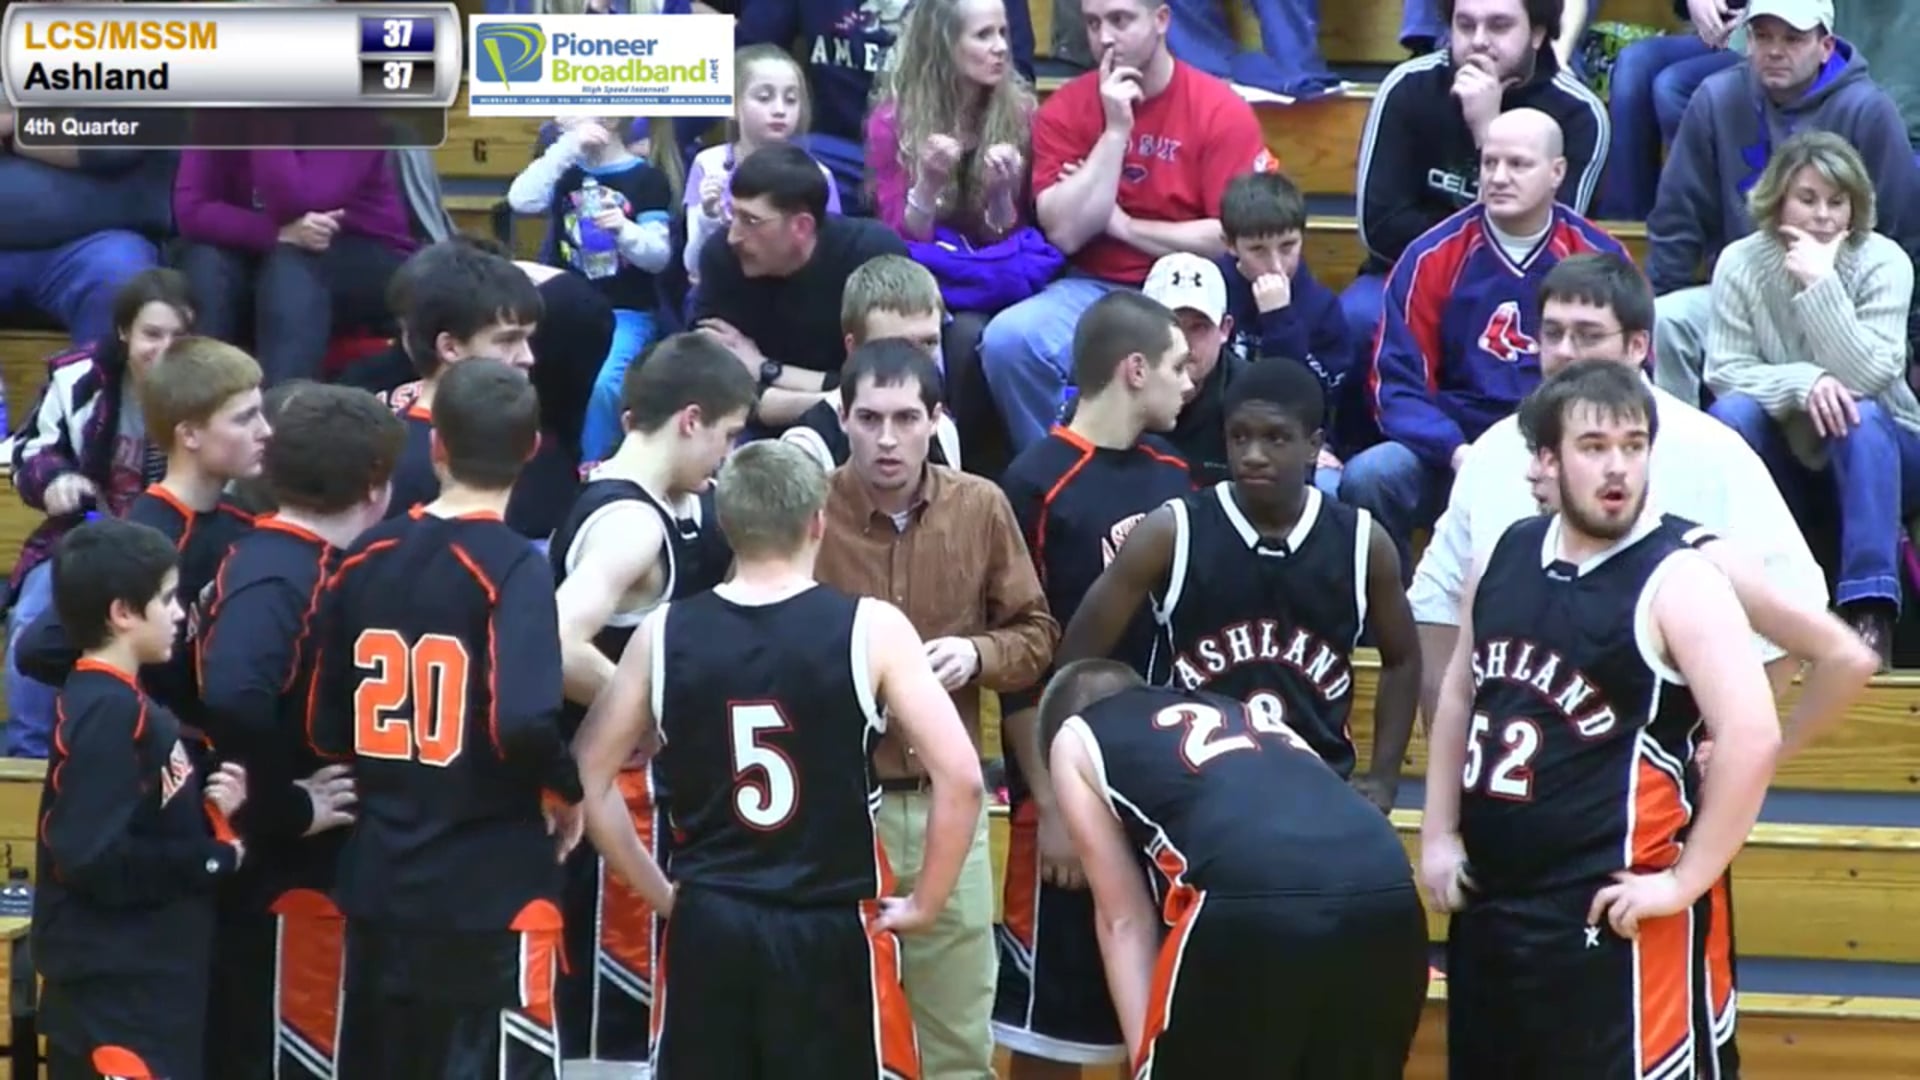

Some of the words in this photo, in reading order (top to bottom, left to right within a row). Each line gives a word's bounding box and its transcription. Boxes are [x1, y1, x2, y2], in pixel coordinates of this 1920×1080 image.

[472, 138, 488, 163] G
[354, 627, 470, 768] 20
[1174, 618, 1352, 702] ASHLAND
[726, 699, 801, 832] 5
[1461, 708, 1544, 800] 52
